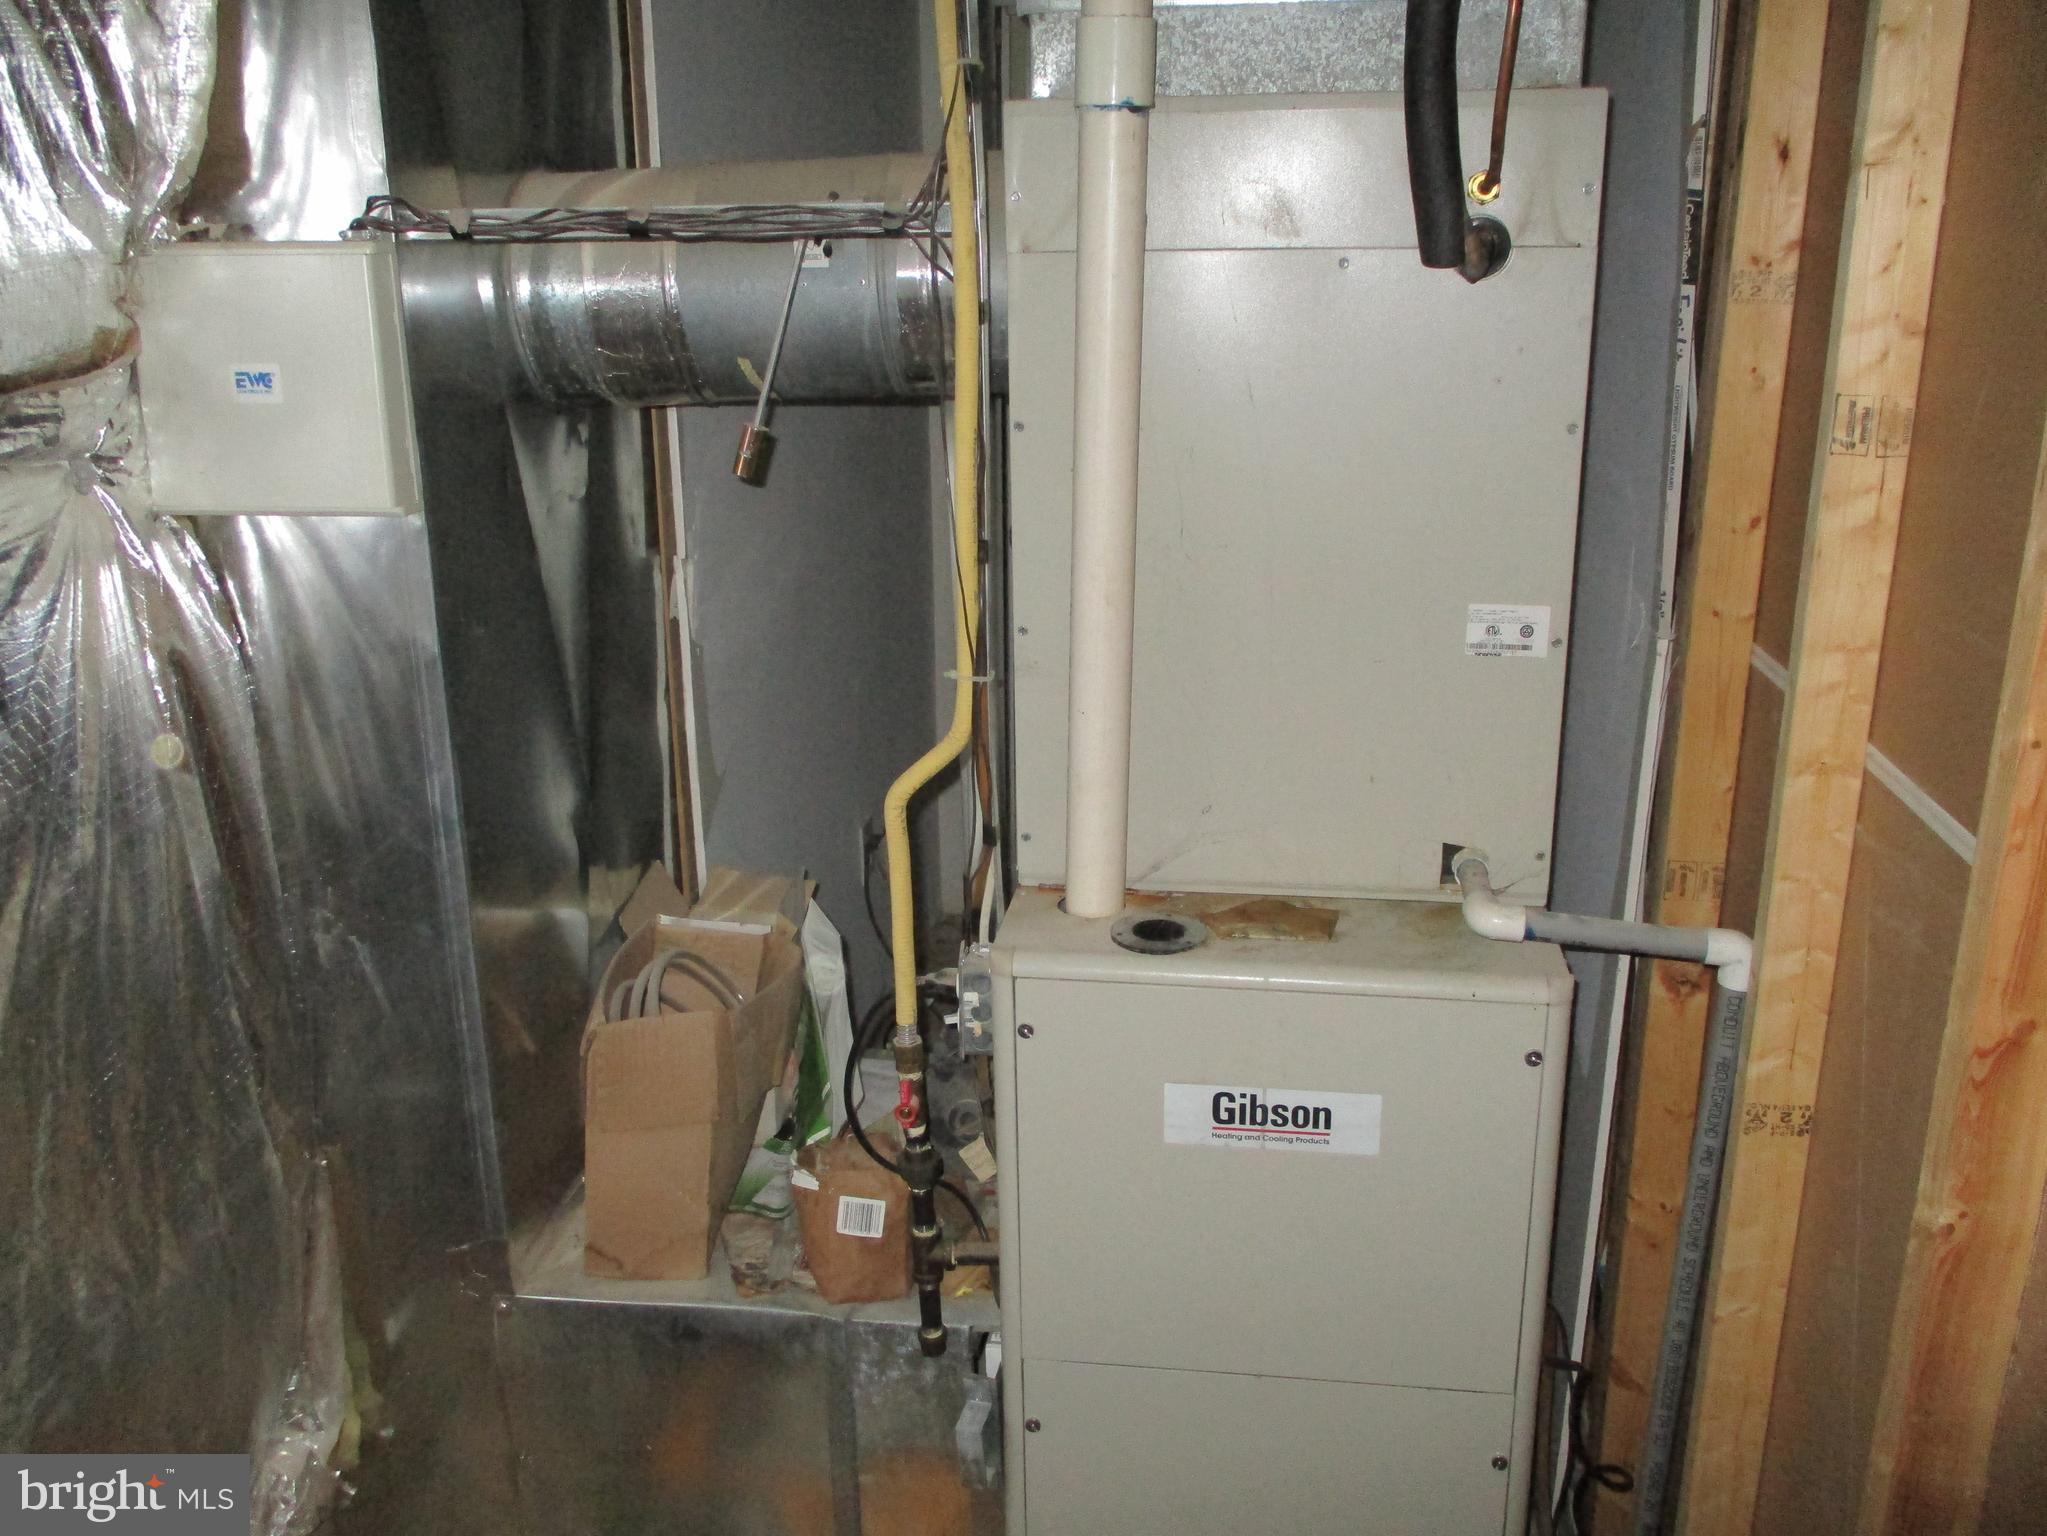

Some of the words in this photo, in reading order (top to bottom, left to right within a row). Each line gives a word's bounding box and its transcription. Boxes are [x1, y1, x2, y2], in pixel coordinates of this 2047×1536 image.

[1721, 995, 1742, 1051] CONDUIT
[1212, 1091, 1332, 1130] Gibson
[1211, 1132, 1243, 1142] Heating
[1244, 1134, 1261, 1142] and
[1262, 1134, 1294, 1145] Cooling
[1295, 1136, 1330, 1146] Products
